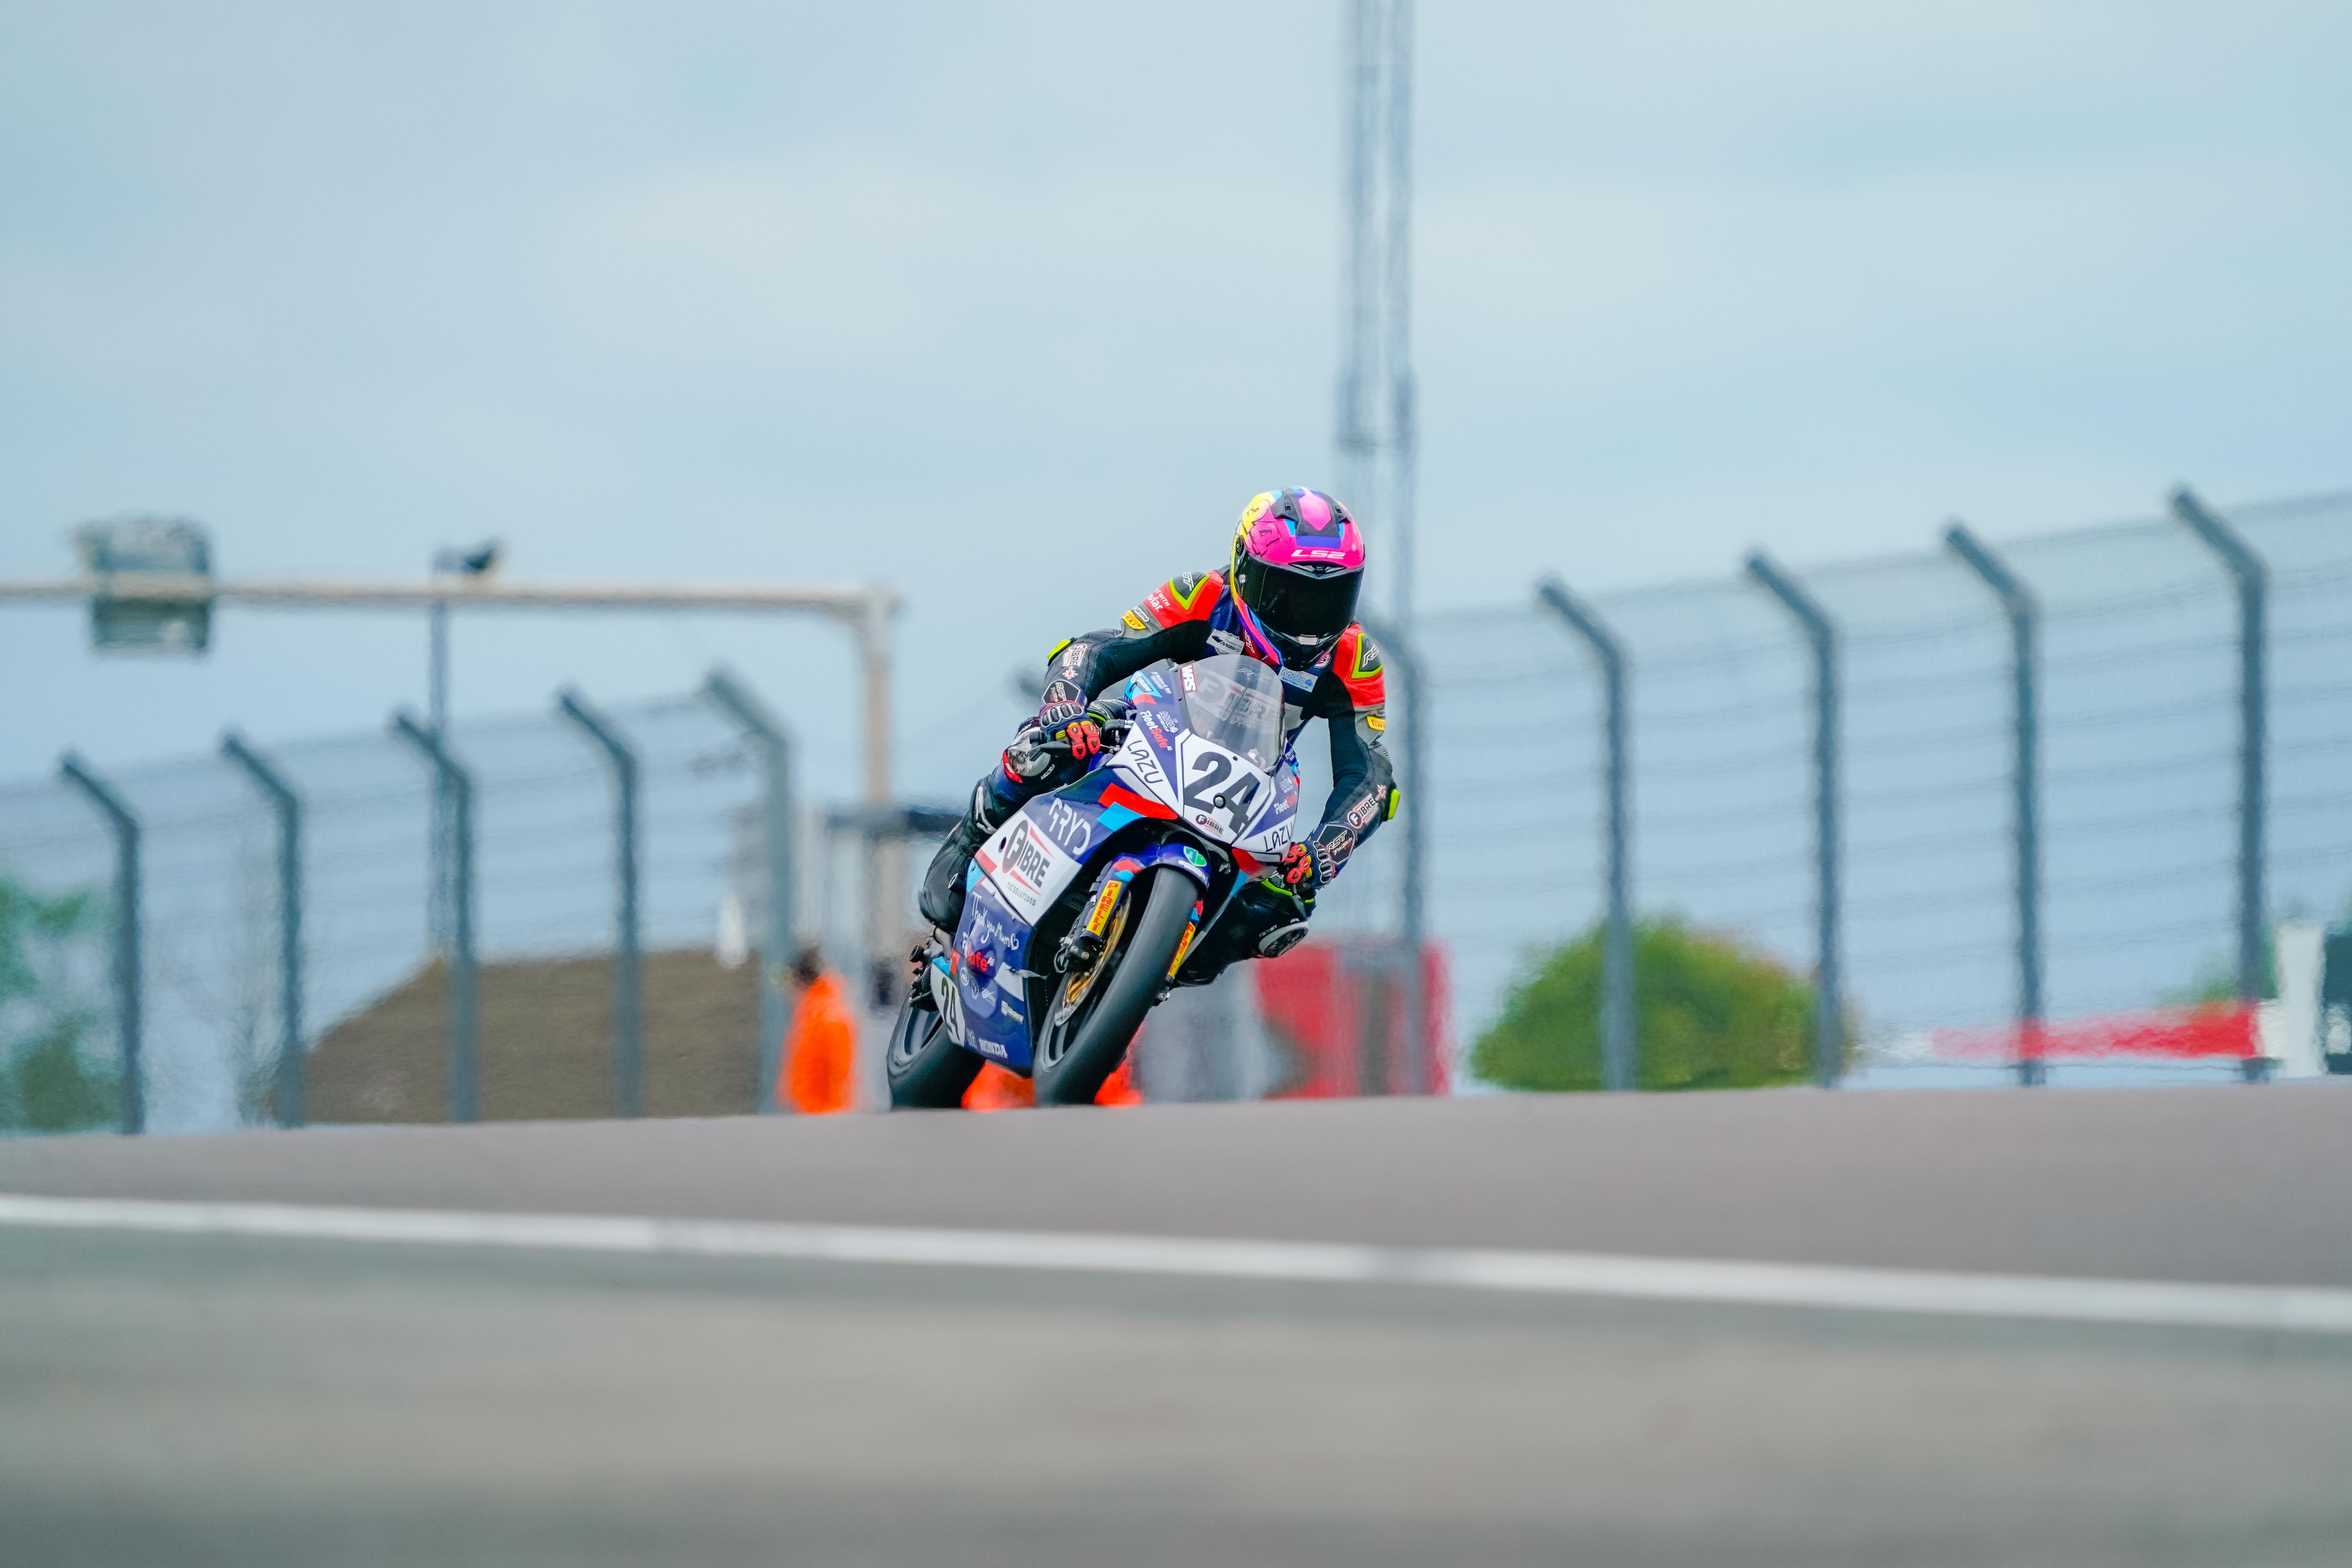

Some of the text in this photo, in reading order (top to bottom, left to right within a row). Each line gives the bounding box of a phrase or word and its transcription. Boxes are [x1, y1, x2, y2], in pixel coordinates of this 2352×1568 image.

[1291, 549, 1346, 559] LS2
[1055, 682, 1067, 700] RST
[1182, 665, 1197, 691] WRS
[1127, 740, 1163, 784] LAZU
[1184, 752, 1261, 835] 24
[1197, 815, 1224, 833] FIBRE
[1349, 798, 1376, 826] FIBRE
[1005, 823, 1051, 888] FIBRE
[1327, 830, 1348, 853] RST
[1092, 883, 1118, 931] PIRELLI
[941, 977, 960, 1041] 24
